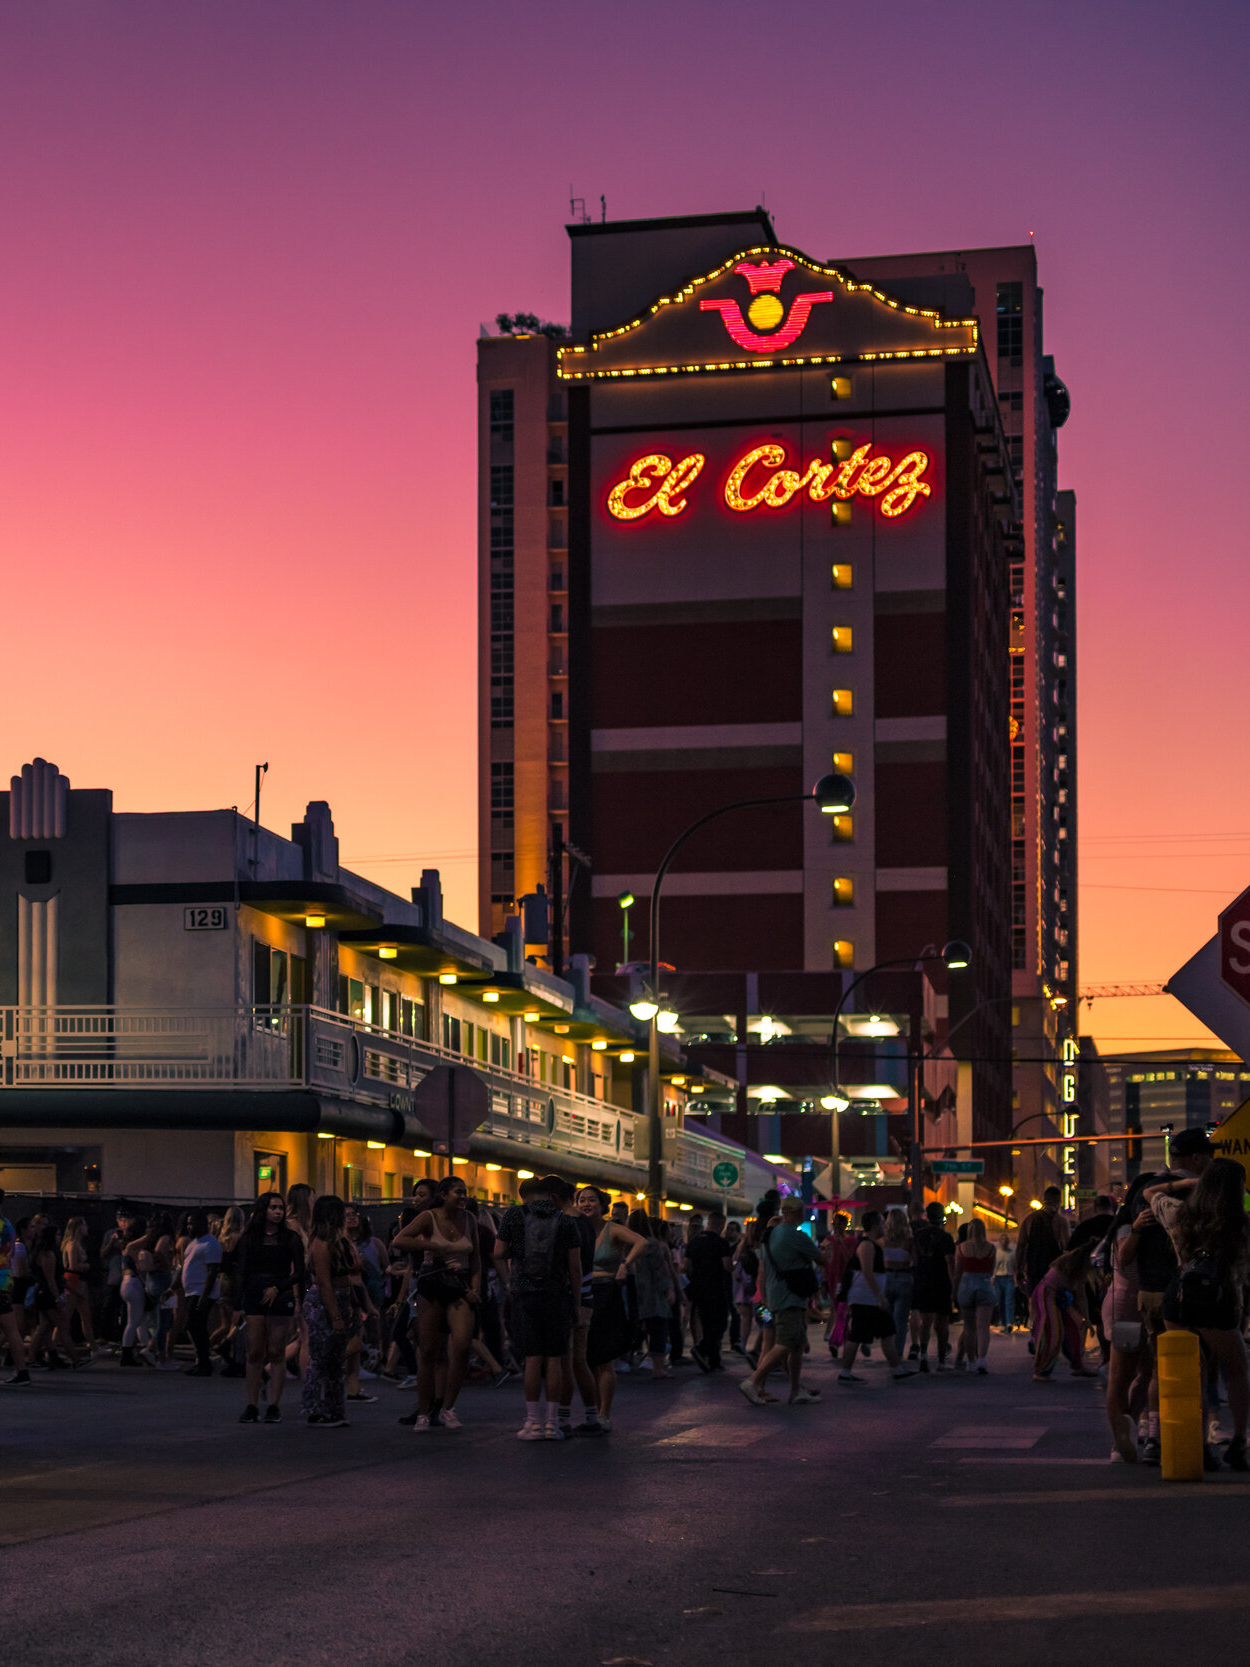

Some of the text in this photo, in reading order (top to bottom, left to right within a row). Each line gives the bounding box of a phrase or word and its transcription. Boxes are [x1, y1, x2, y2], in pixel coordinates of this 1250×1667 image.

[607, 441, 932, 520] El Cortez
[189, 909, 223, 927] 129
